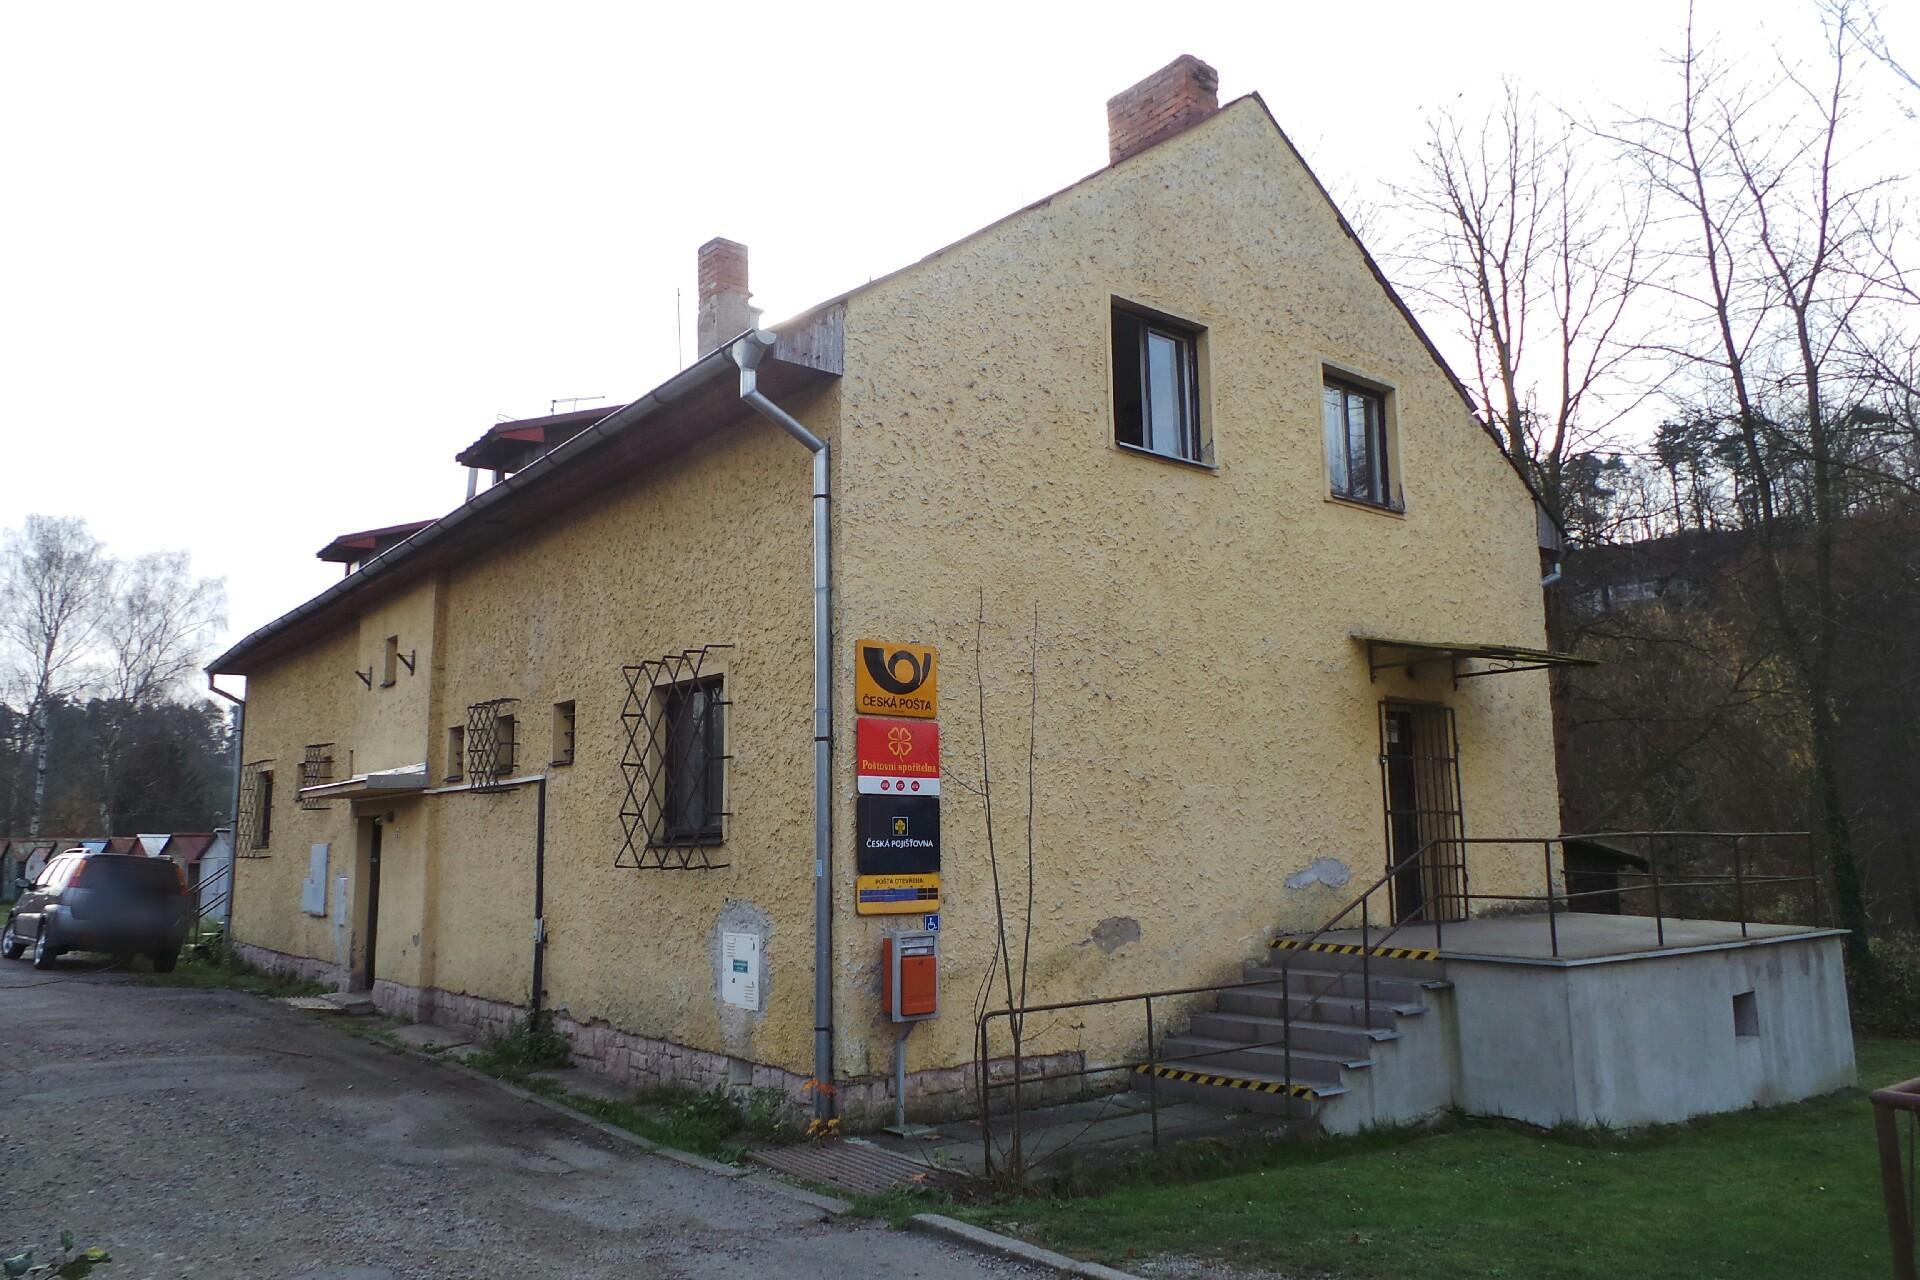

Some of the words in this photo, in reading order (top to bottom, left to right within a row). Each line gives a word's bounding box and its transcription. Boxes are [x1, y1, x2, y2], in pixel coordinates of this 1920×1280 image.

[863, 694, 896, 708] ČESKÁ
[900, 698, 931, 710] POŠTA
[862, 760, 896, 770] Poštovní
[898, 762, 937, 773] spořitelna
[866, 838, 890, 848] ČESKÁ
